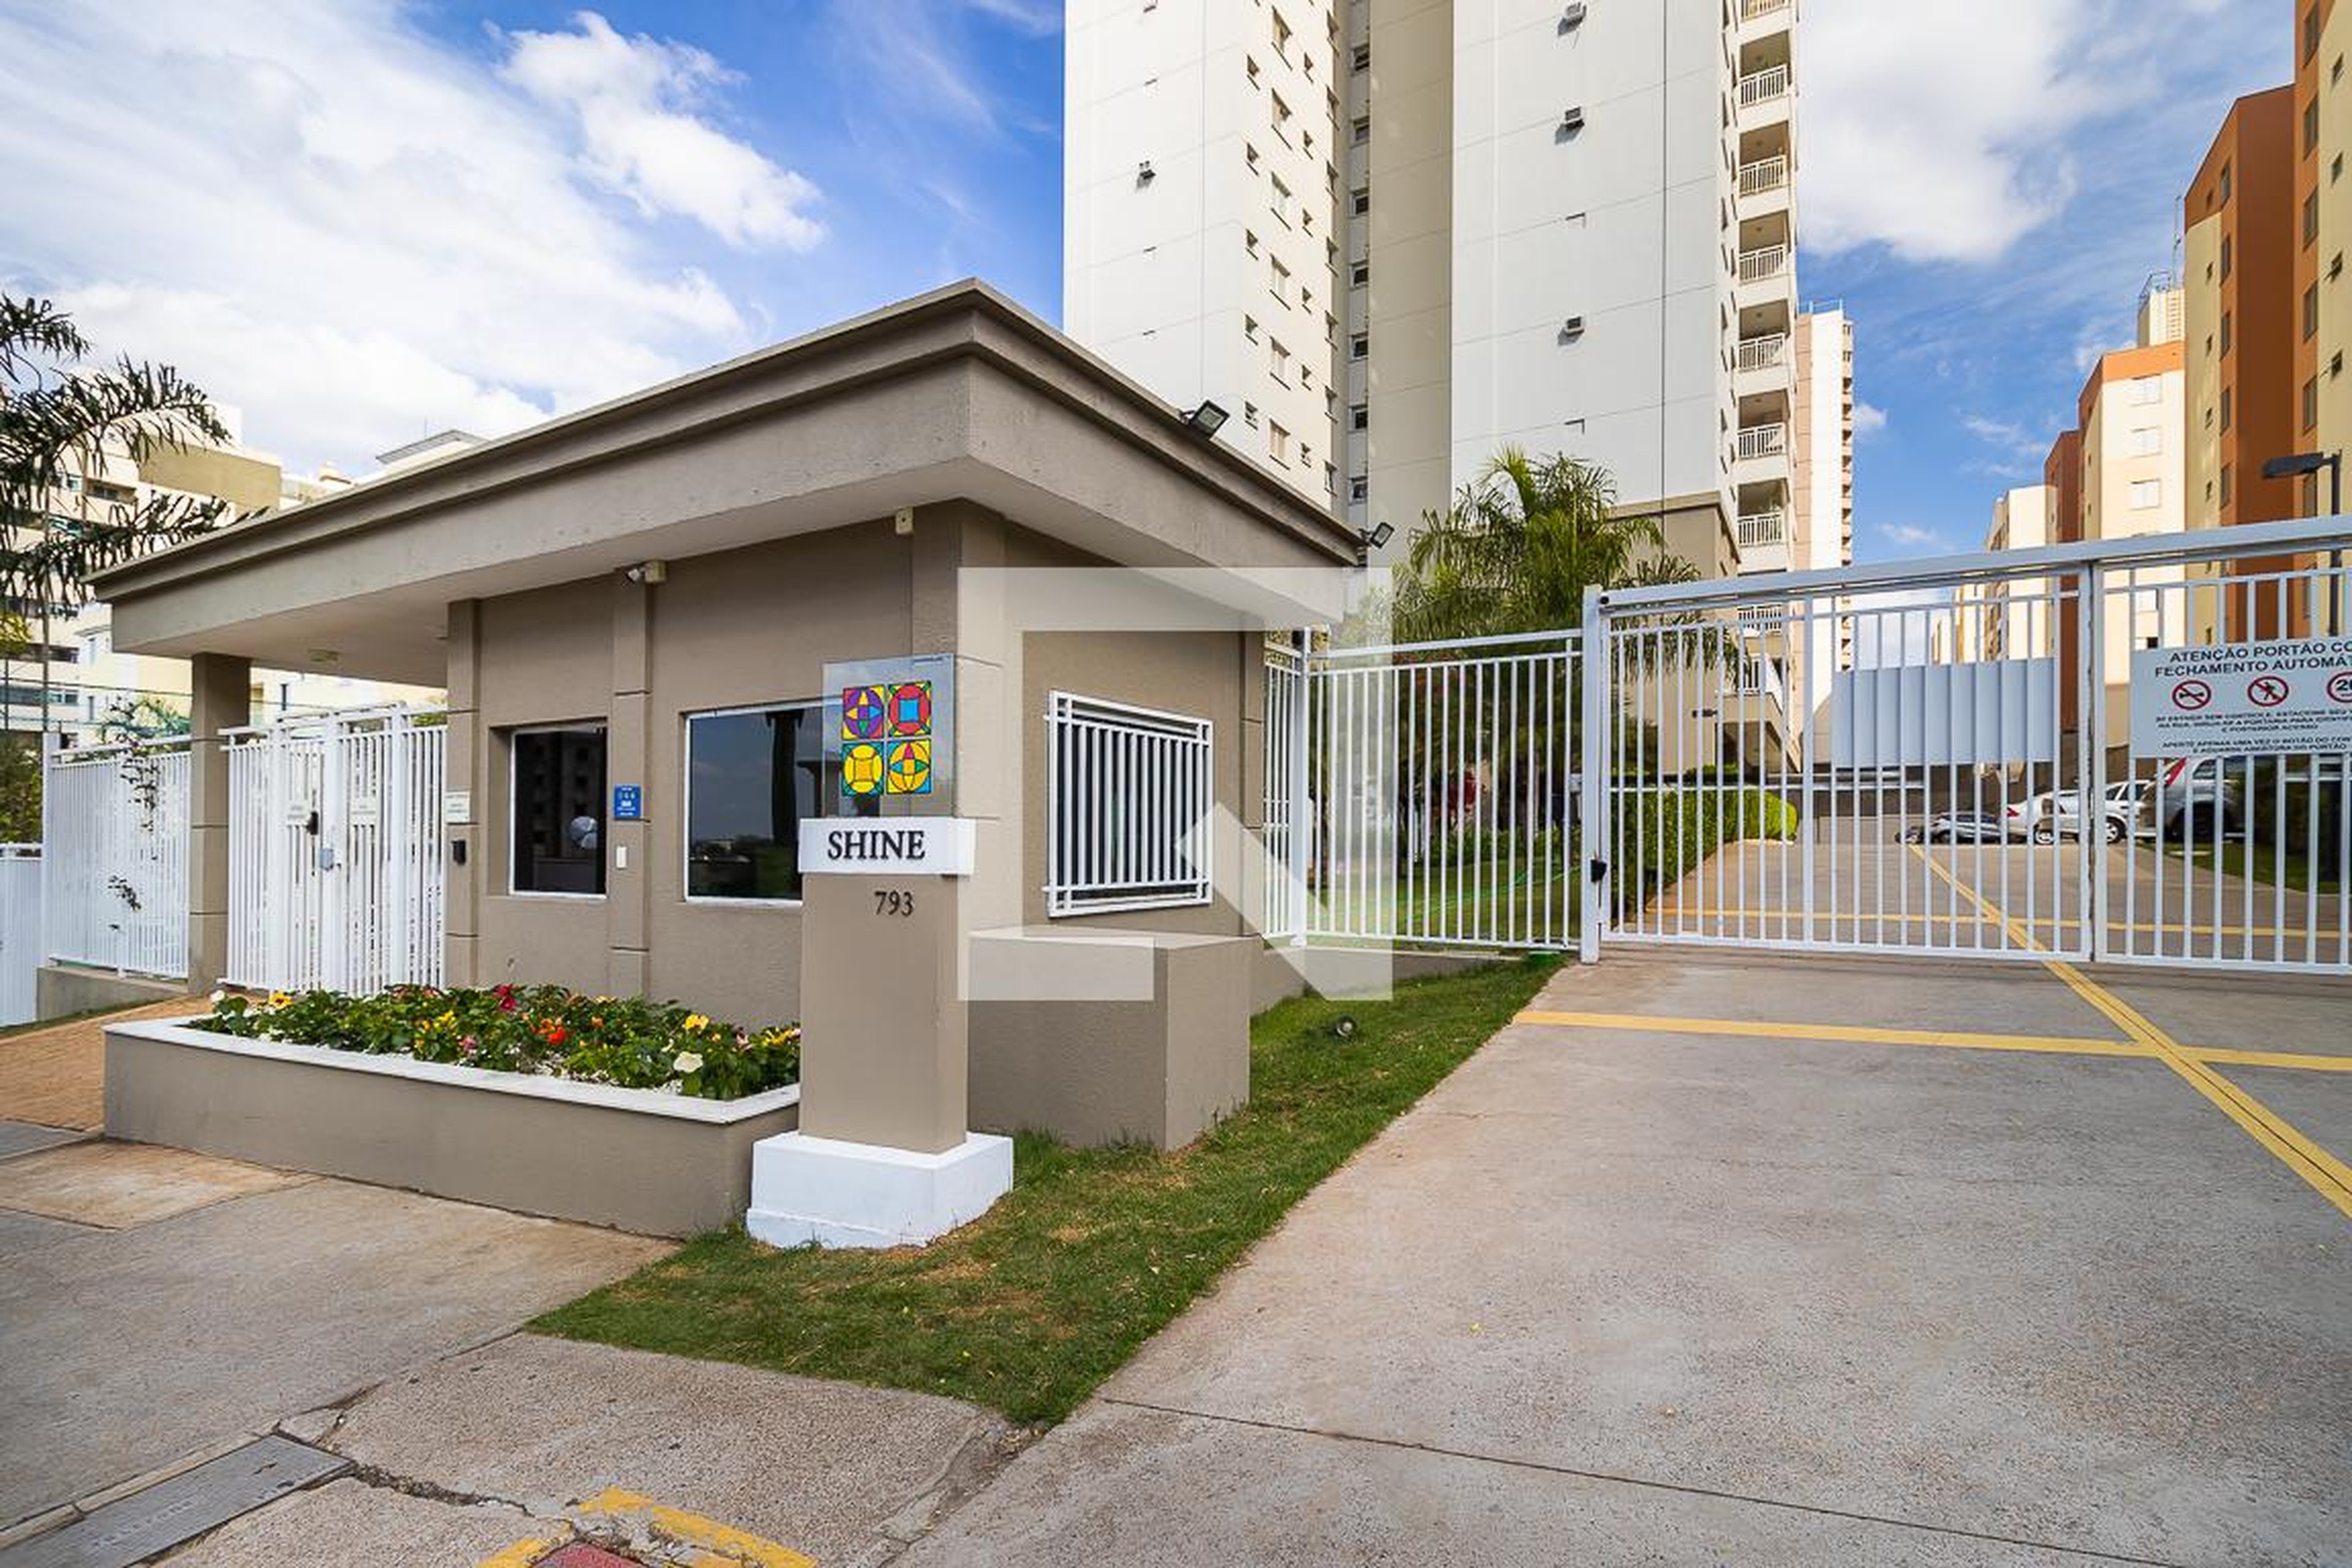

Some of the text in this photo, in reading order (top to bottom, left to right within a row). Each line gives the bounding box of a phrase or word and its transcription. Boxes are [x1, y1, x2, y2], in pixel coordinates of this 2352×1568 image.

[2170, 647, 2248, 662] ATENÇÃO
[2254, 641, 2326, 657] PORTÃO
[2155, 660, 2267, 677] FECHAMENTO
[828, 831, 925, 859] SHINE
[874, 890, 913, 917] 793
